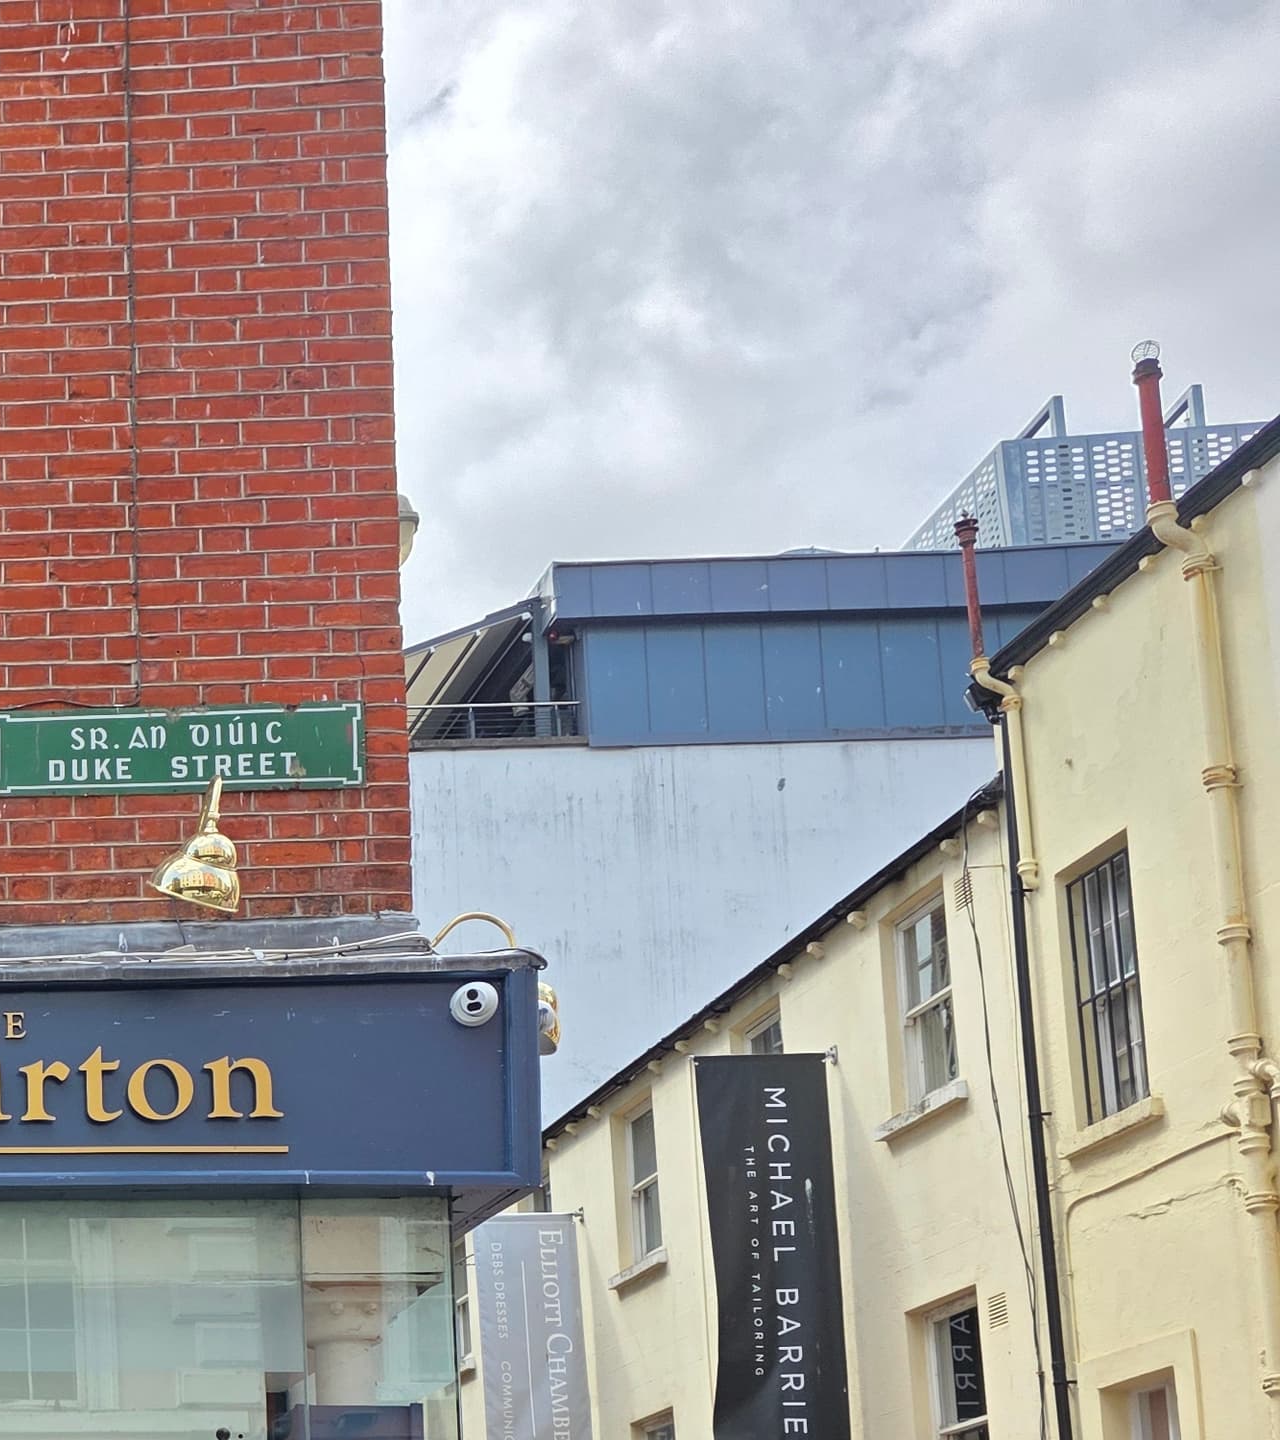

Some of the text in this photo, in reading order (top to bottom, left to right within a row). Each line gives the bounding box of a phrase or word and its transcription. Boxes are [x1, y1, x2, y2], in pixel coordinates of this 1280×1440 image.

[48, 751, 298, 782] DUKE STREET
[490, 1241, 509, 1340] DEBS DRESSES
[744, 1145, 765, 1376] THE ART OF TAILORING
[763, 1087, 809, 1434] MICHAEL BARRIE
